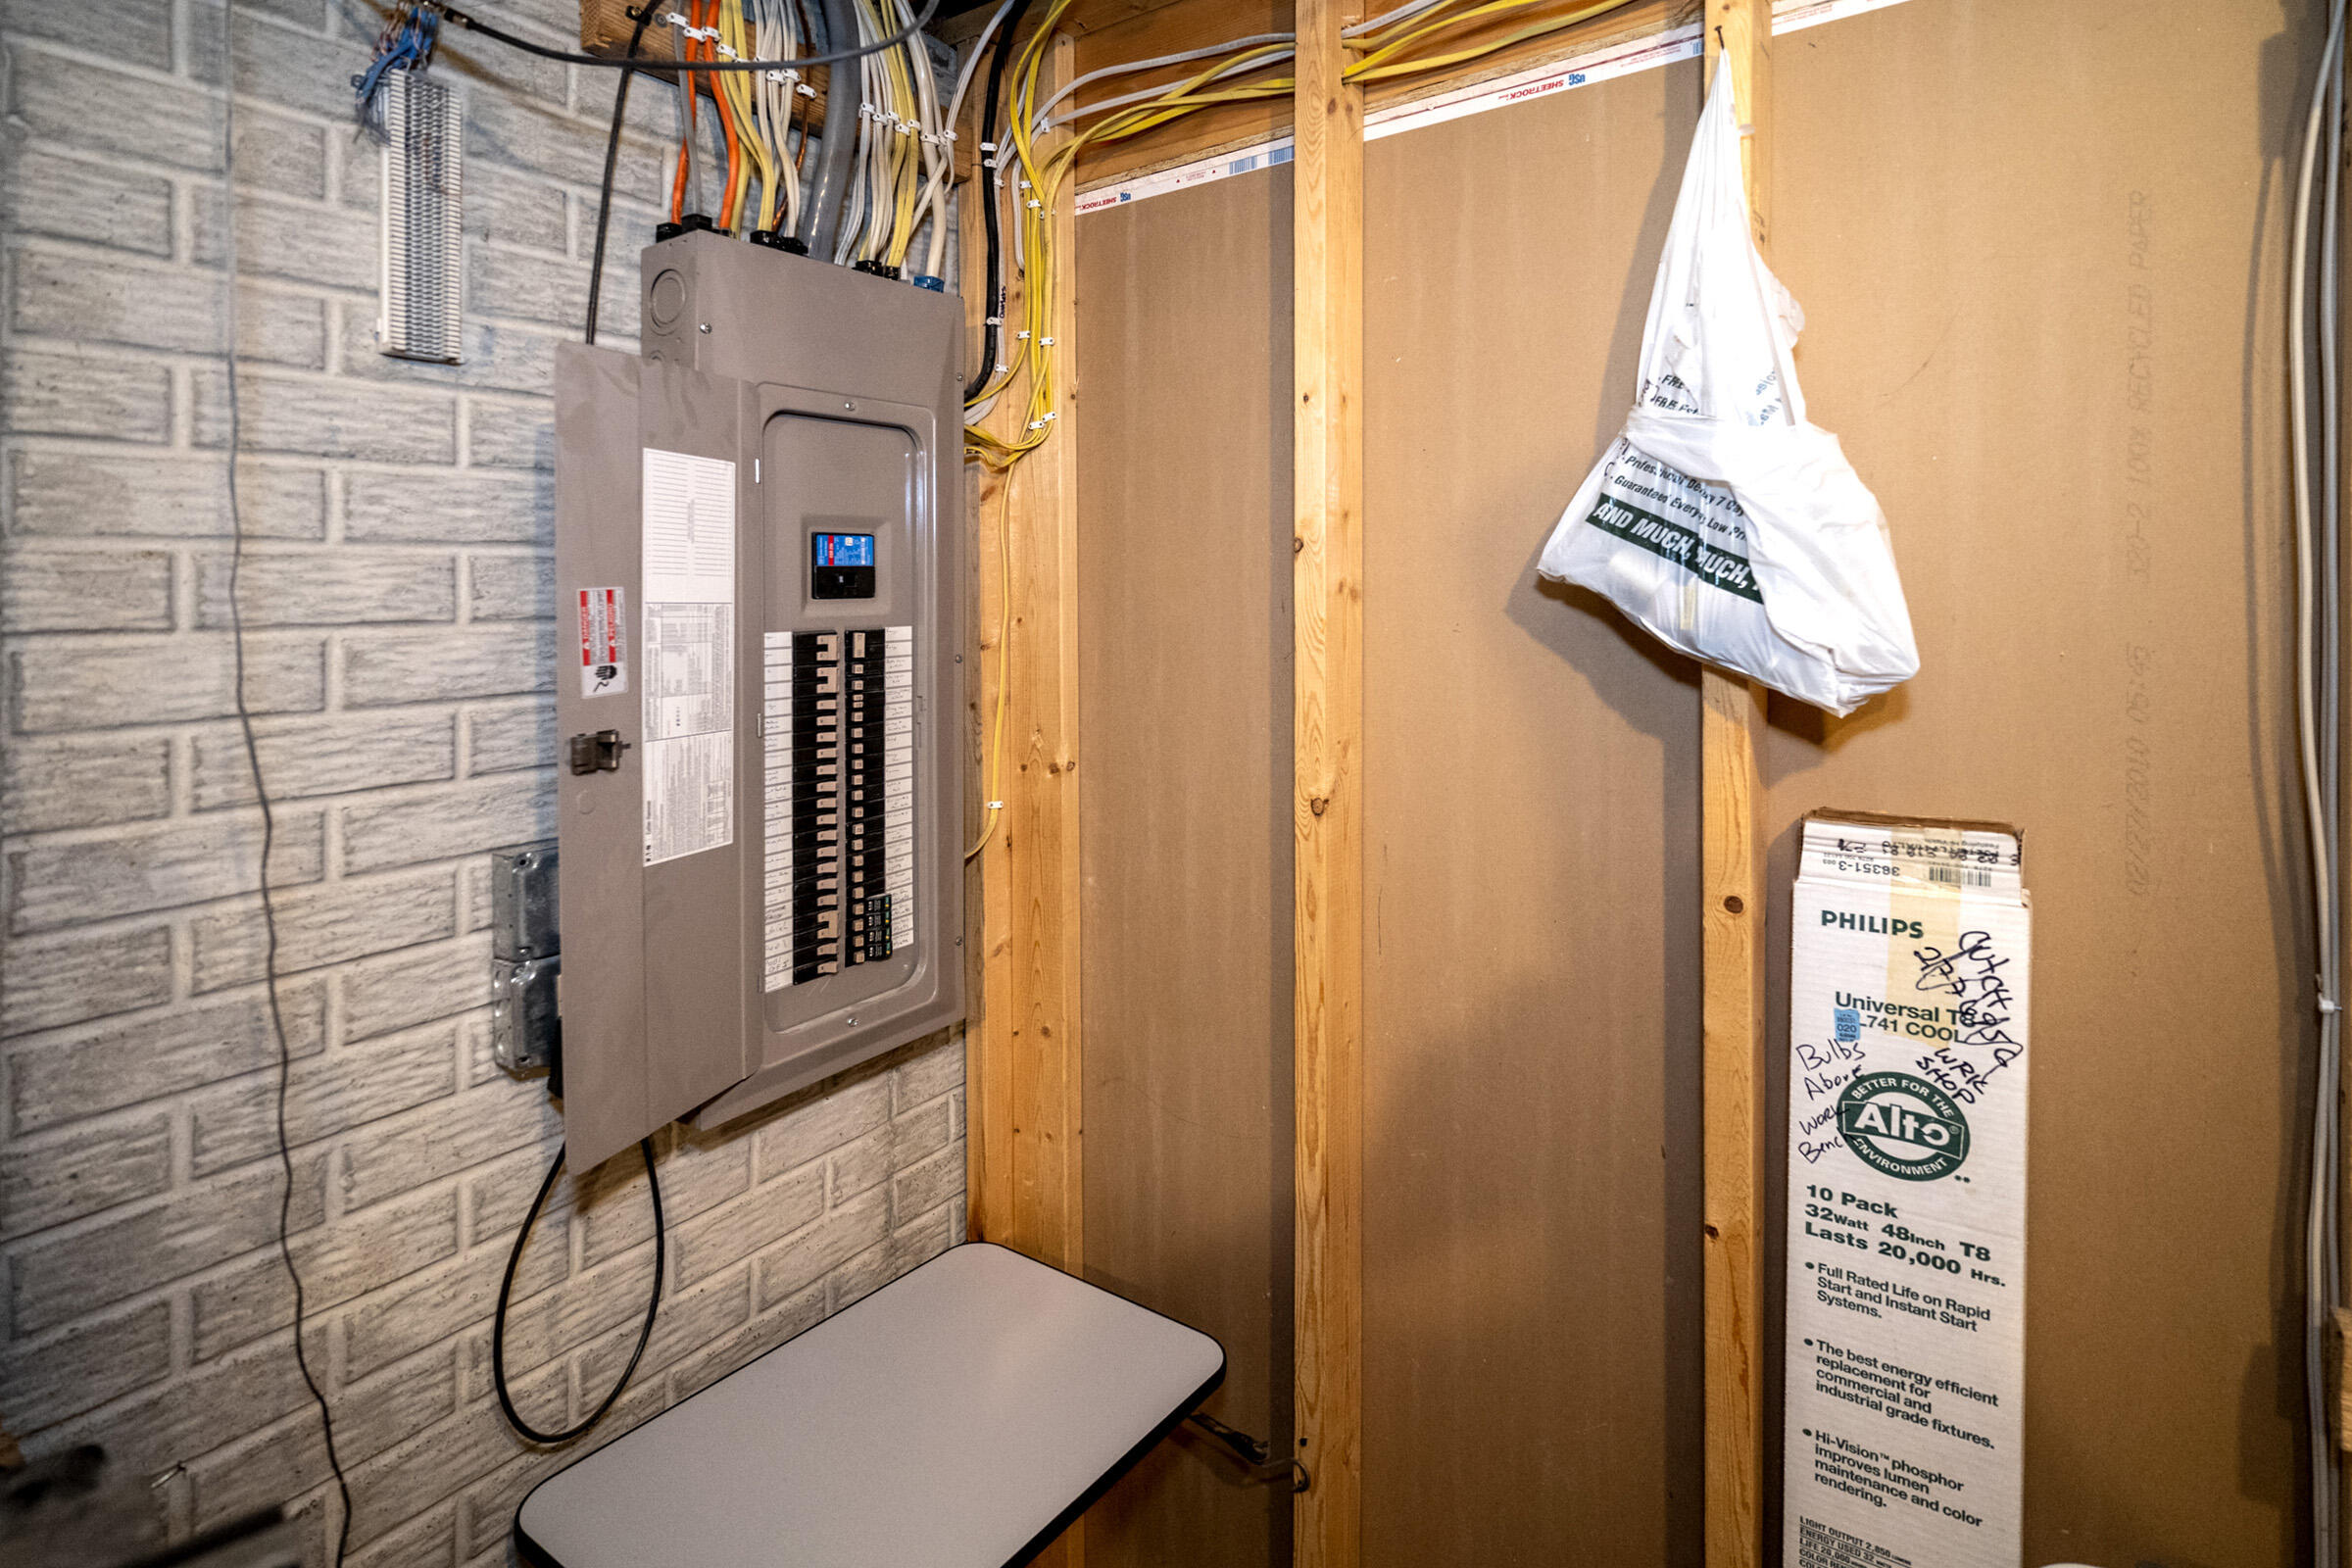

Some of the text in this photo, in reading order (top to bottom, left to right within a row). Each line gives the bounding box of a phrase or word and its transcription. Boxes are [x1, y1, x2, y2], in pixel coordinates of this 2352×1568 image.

[1509, 79, 1565, 100] SHEETROCK
[1568, 74, 1586, 86] USG
[2127, 189, 2153, 270] PAPER
[1592, 502, 1634, 529] AND
[1630, 517, 1696, 561] MUCH,
[1707, 514, 1728, 534] Low
[1821, 909, 1925, 940] PHILIPS
[1835, 990, 1939, 1022] Universal
[1904, 1022, 1966, 1045] COOL
[1795, 1039, 1867, 1071] Bulbs
[1850, 1078, 1955, 1118] BETTER FOR THE
[1915, 1055, 1976, 1104] SHOP
[1853, 1102, 1951, 1147] Alto
[1852, 1138, 1948, 1176] ENVIRONMENT
[1806, 1184, 1898, 1218] 10 Pack
[1804, 1222, 2007, 1288] Lasts 20,000 Hrs.
[1959, 1242, 1991, 1262] T8
[1816, 1289, 1883, 1320] Systems.
[1817, 1262, 1991, 1323] Full Rated Life on Rapid
[1817, 1276, 1978, 1333] Start and Instant Start
[1816, 1339, 2000, 1408] The best energy efficient
[1816, 1355, 1932, 1399] replacement for
[1816, 1369, 1933, 1414] commercial and
[1815, 1380, 1996, 1450] industrial grade fixtures.
[1814, 1444, 1931, 1495] improves lumen
[1891, 1458, 1965, 1493] phosphor
[1814, 1472, 1887, 1509] rendering.
[1814, 1458, 1984, 1529] maintenance and color
[1799, 1515, 1828, 1533] LIGHT
[1828, 1527, 1865, 1547] OUTPUT
[1799, 1525, 1837, 1546] ENERGY
[1837, 1542, 1862, 1558] USED
